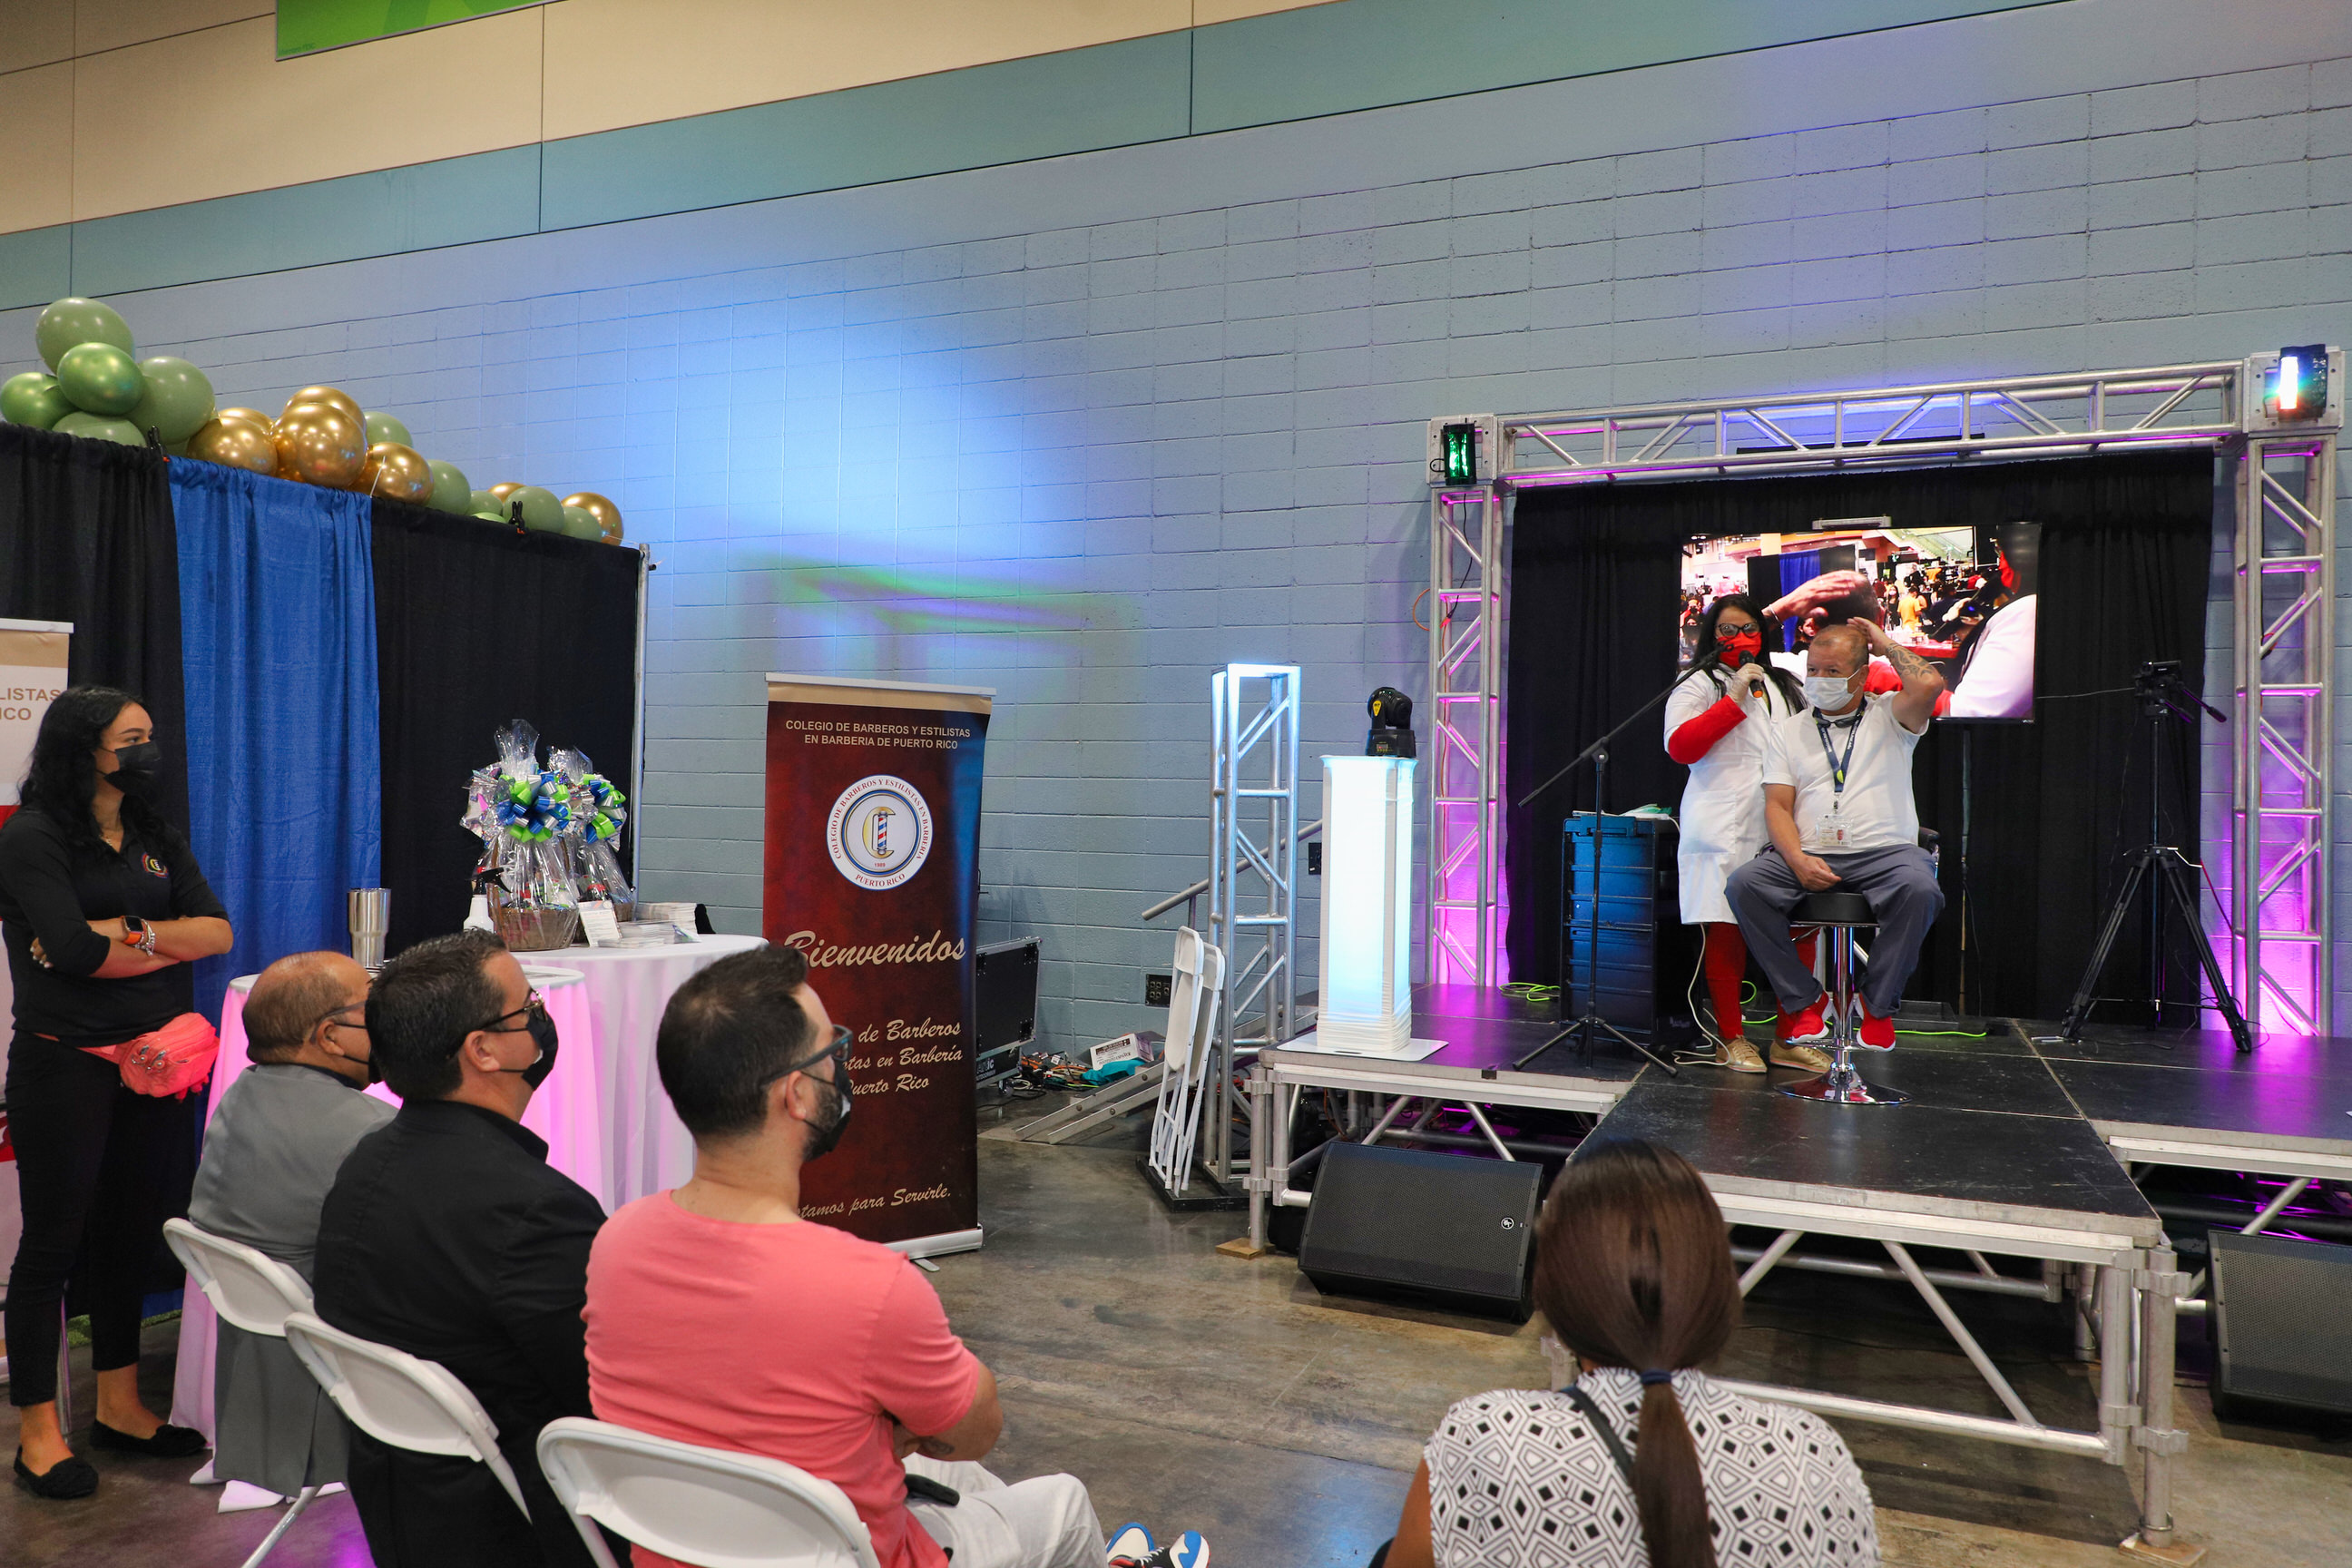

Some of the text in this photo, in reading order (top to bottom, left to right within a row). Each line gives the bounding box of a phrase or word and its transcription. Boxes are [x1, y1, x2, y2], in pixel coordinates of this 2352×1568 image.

[785, 720, 971, 738] COLEGIO DE BARBEROS Y ESTILISTAS
[804, 734, 958, 750] EN BARBERIA DE PUERTO RICO
[839, 779, 877, 807] BARBEROS
[885, 779, 922, 807] ESTILISTAS
[834, 808, 842, 818] DE
[918, 806, 926, 817] EN
[830, 819, 842, 859] COLEGIO
[916, 818, 929, 859] BARBERIA
[855, 873, 906, 887] PUERTO RICO
[783, 929, 966, 968] Bienvenidos
[858, 1016, 962, 1044] de Barberos
[877, 1055, 894, 1068] en
[899, 1044, 963, 1066] Barbería
[895, 1073, 930, 1093] Rico
[848, 1196, 886, 1216] para
[890, 1182, 951, 1206] Servirle.
